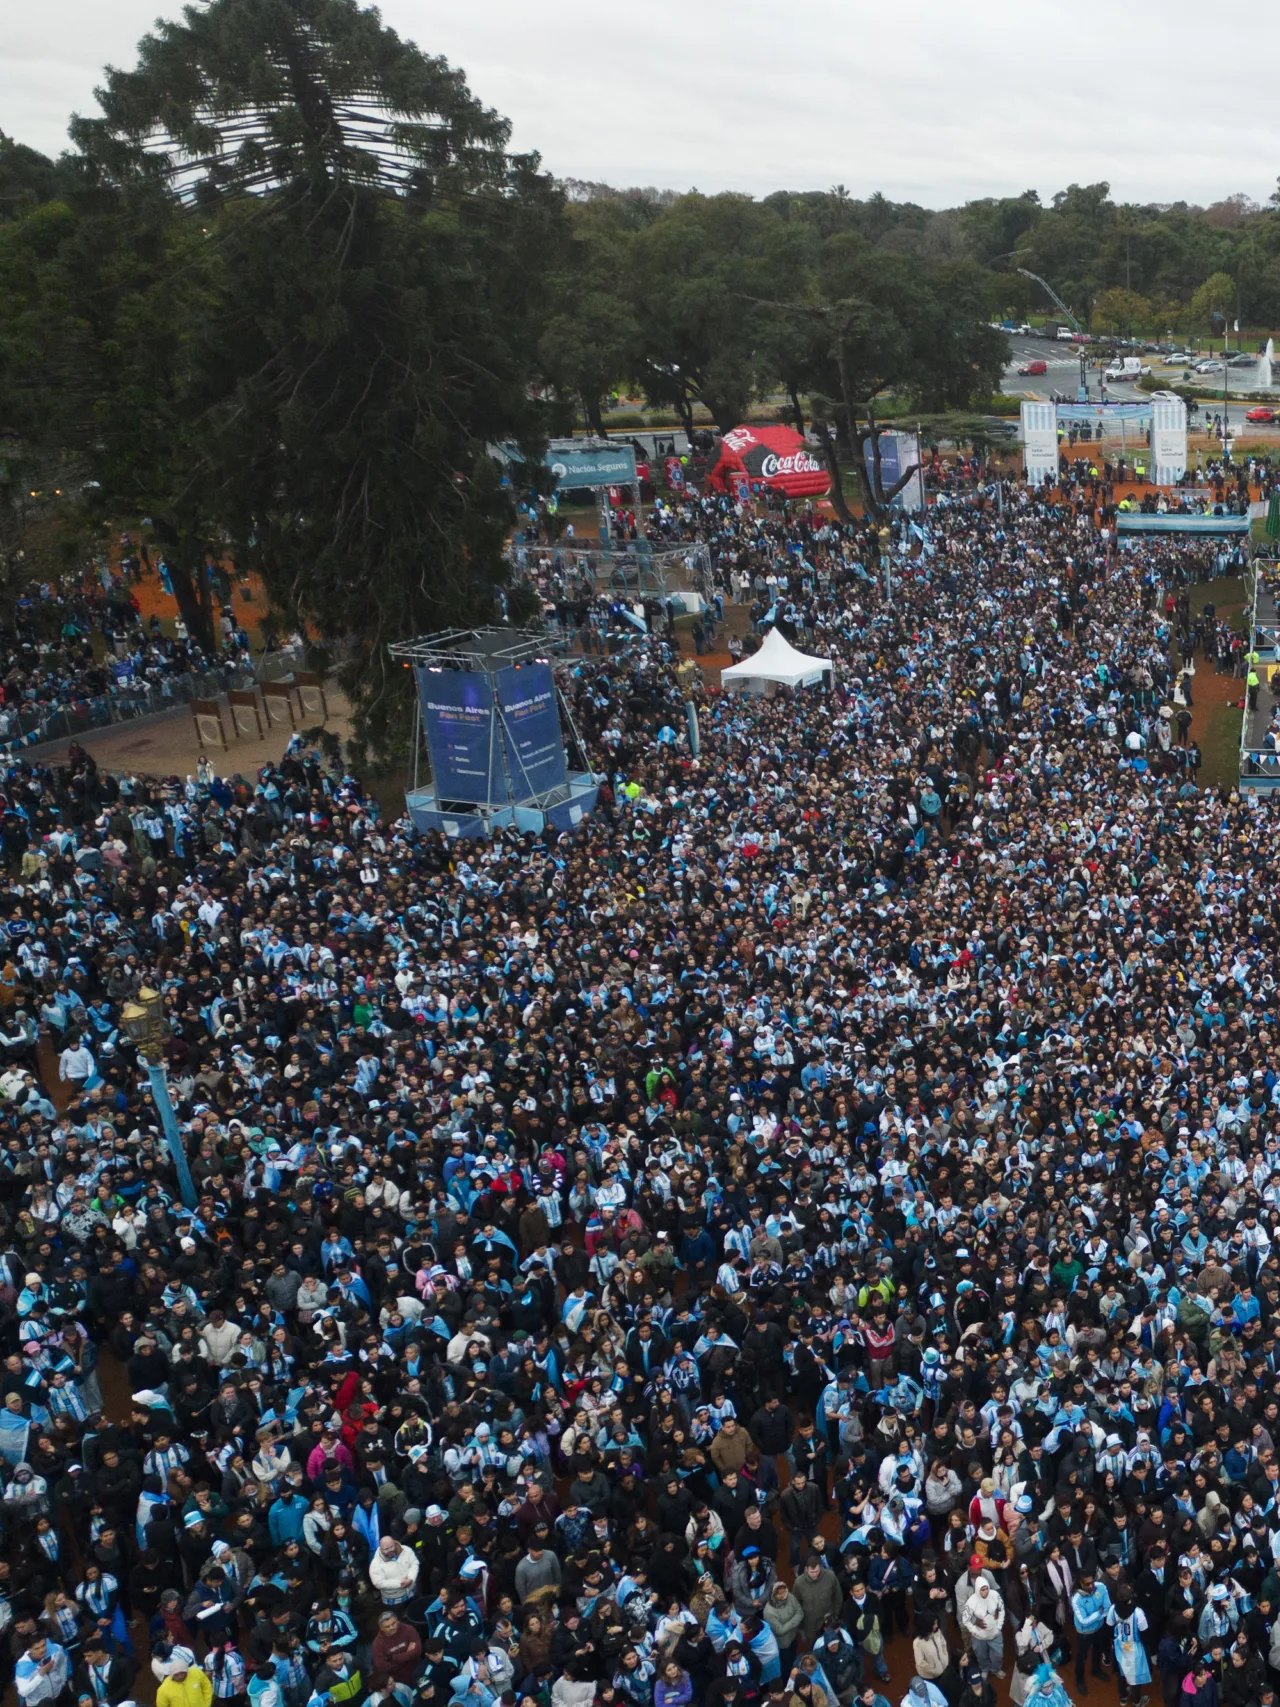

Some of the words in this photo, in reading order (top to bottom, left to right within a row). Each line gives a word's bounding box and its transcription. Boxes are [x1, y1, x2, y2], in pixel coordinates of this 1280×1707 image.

[568, 463, 597, 474] Nación
[597, 462, 628, 473] Seguros
[427, 702, 463, 712] Buenos
[464, 706, 490, 715] Aires
[504, 698, 533, 713] Buenos
[534, 692, 552, 703] Aires
[514, 709, 529, 718] Fan
[530, 702, 546, 713] Fest
[439, 712, 458, 720] Fan
[458, 714, 480, 722] Fest
